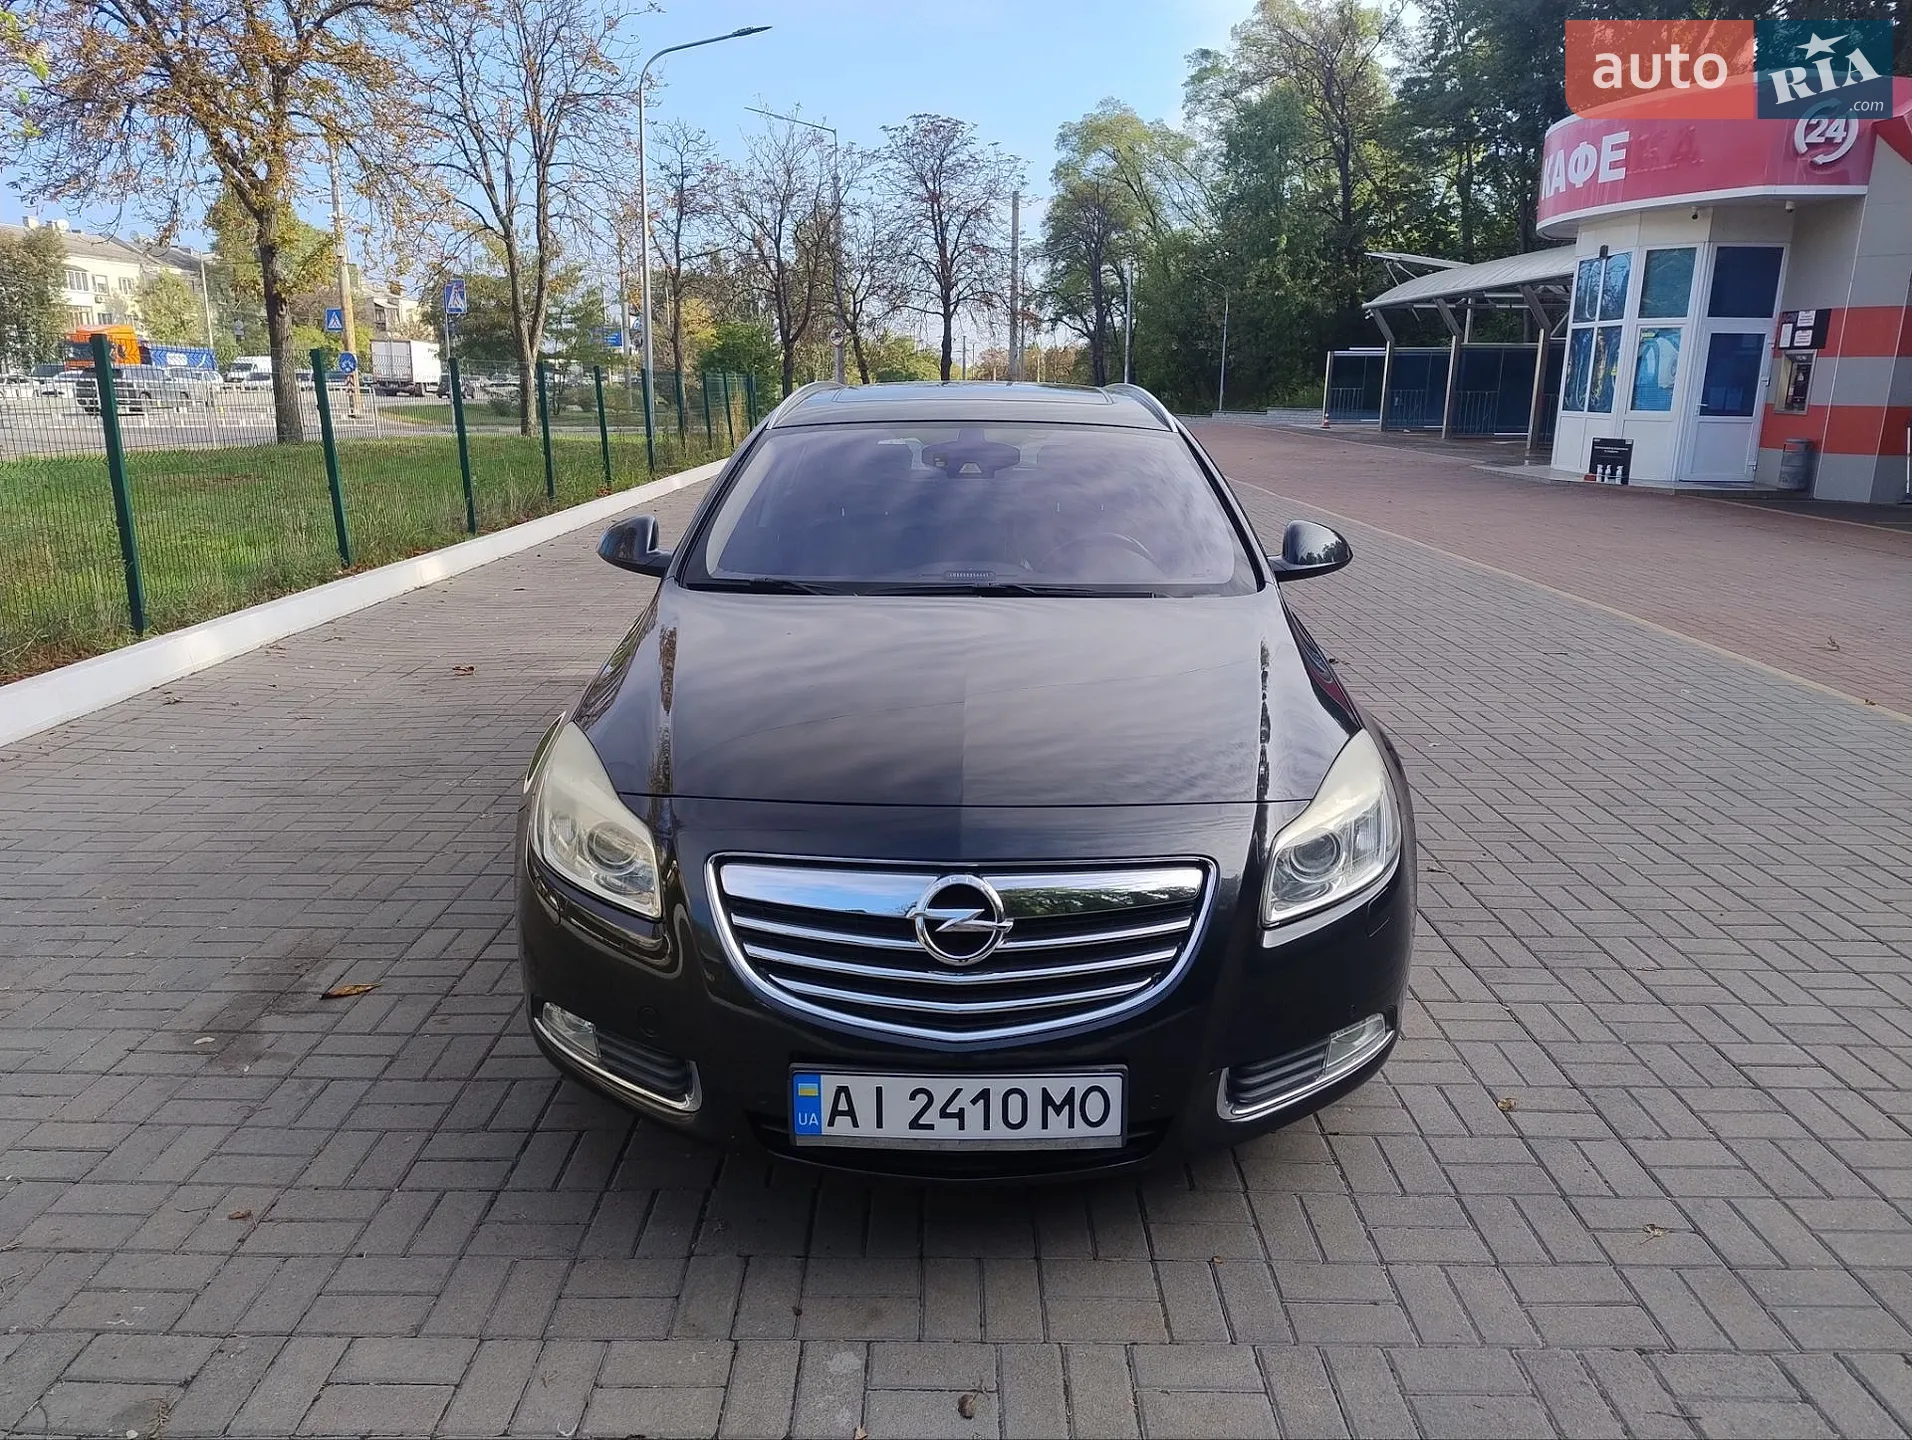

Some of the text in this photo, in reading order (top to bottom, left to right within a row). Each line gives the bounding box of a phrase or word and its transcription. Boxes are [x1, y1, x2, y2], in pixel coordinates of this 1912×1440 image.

[1805, 115, 1847, 143] 24
[1541, 131, 1629, 200] КАФЕ
[797, 1113, 819, 1126] UA
[827, 1085, 1110, 1131] AI 2410 MO
